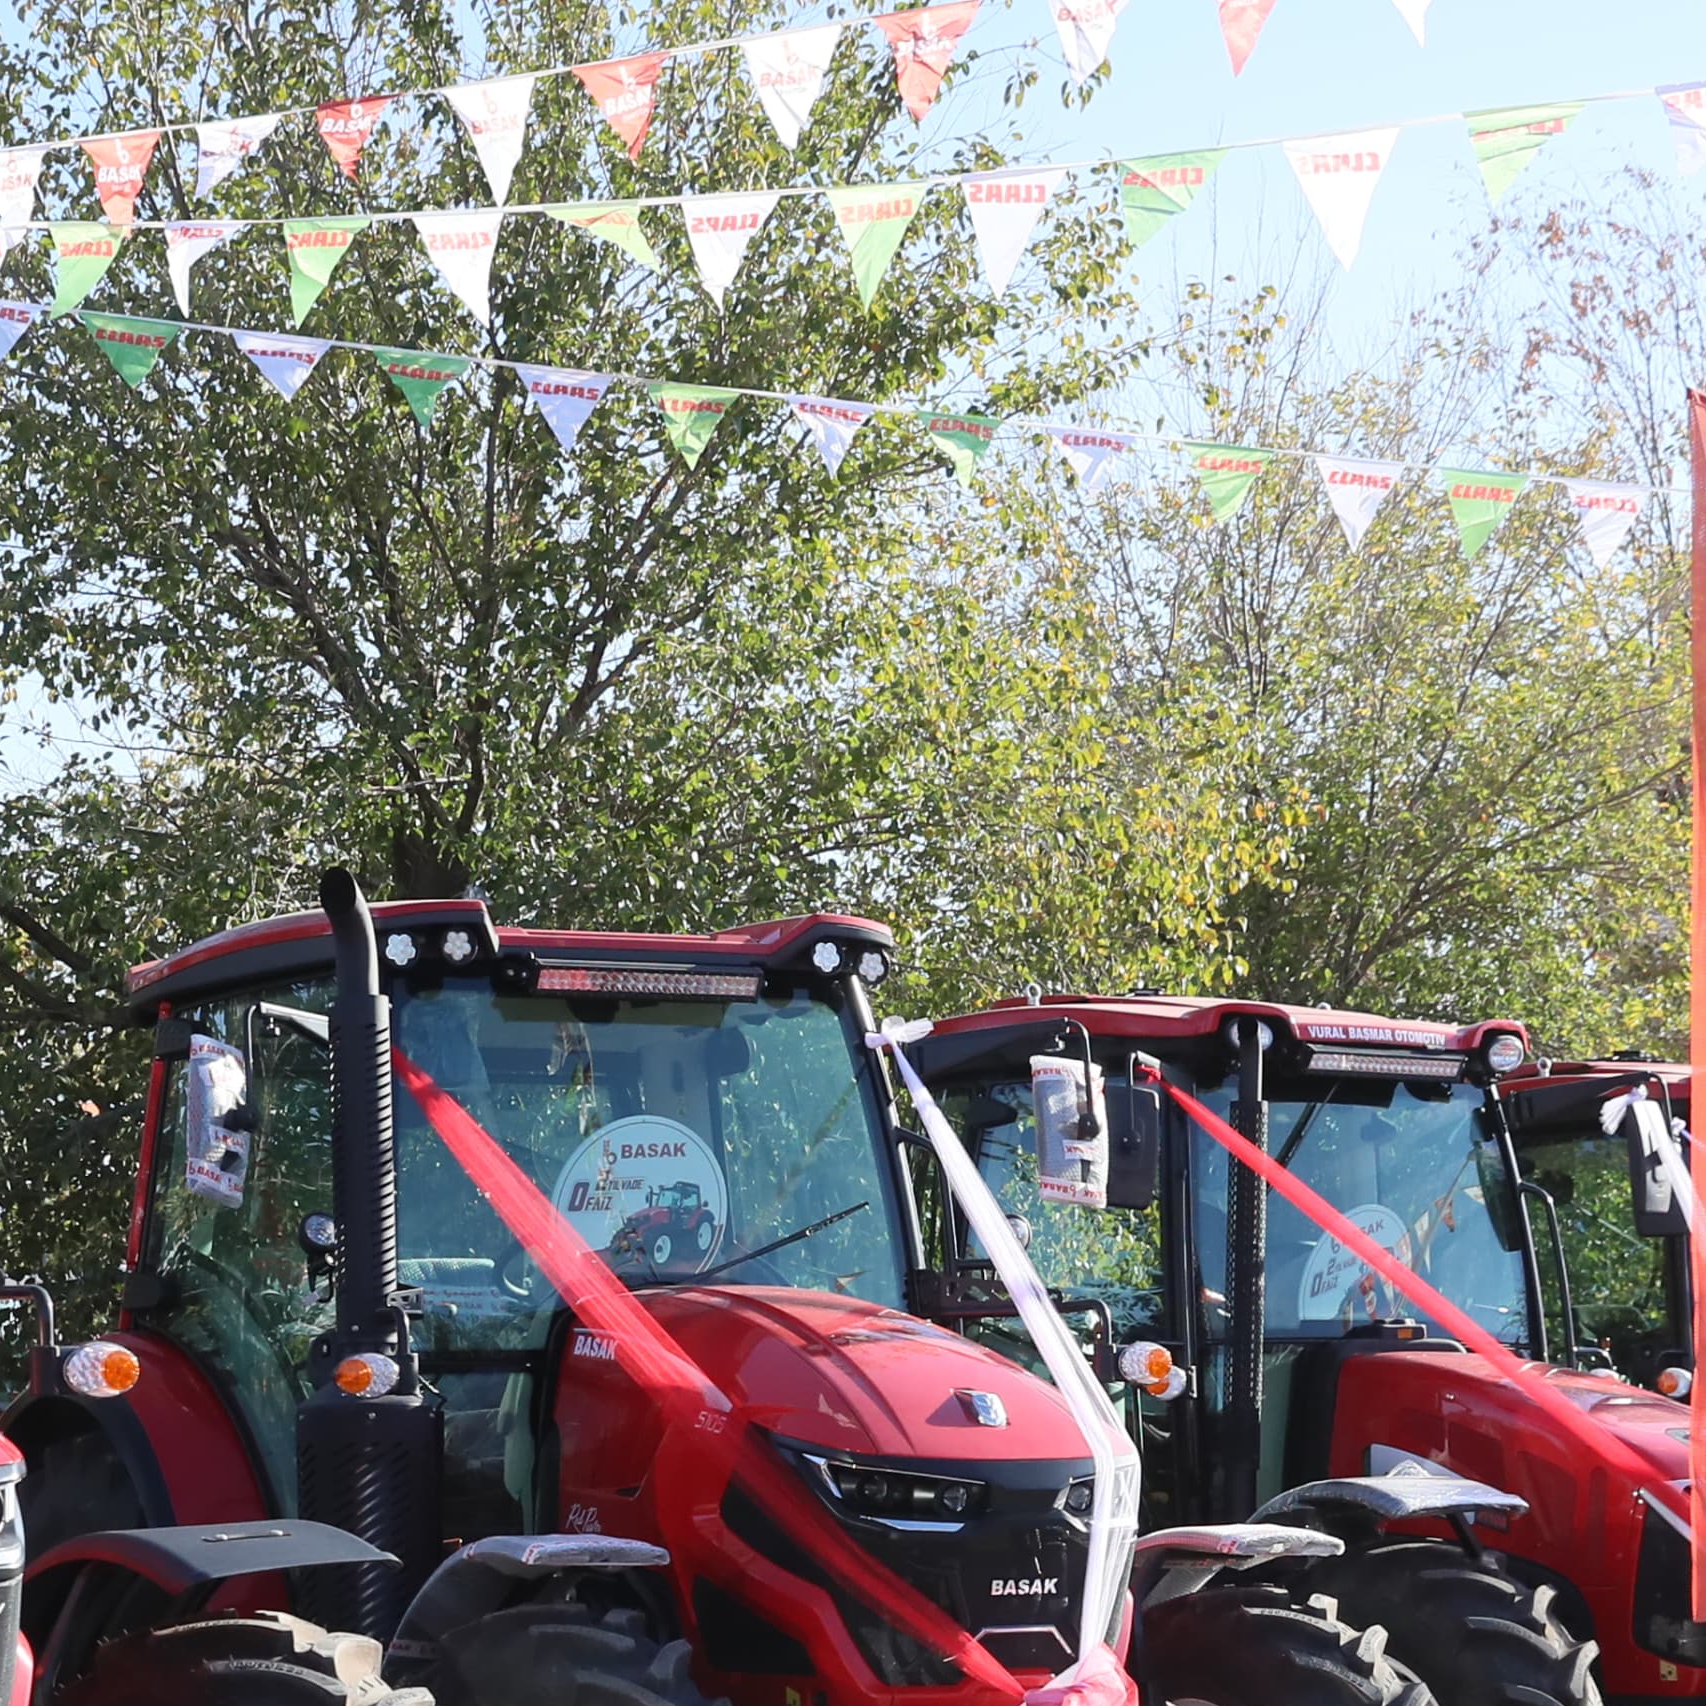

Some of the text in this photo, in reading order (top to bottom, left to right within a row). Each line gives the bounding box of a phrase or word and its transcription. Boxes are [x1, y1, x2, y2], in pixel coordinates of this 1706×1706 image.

[1328, 470, 1392, 489] CLAAS
[1452, 483, 1515, 503] CLAAS
[1308, 1025, 1346, 1039] VURAL
[621, 1142, 687, 1159] BASAK
[574, 1334, 619, 1360] BASAK
[990, 1578, 1059, 1596] BASAK
